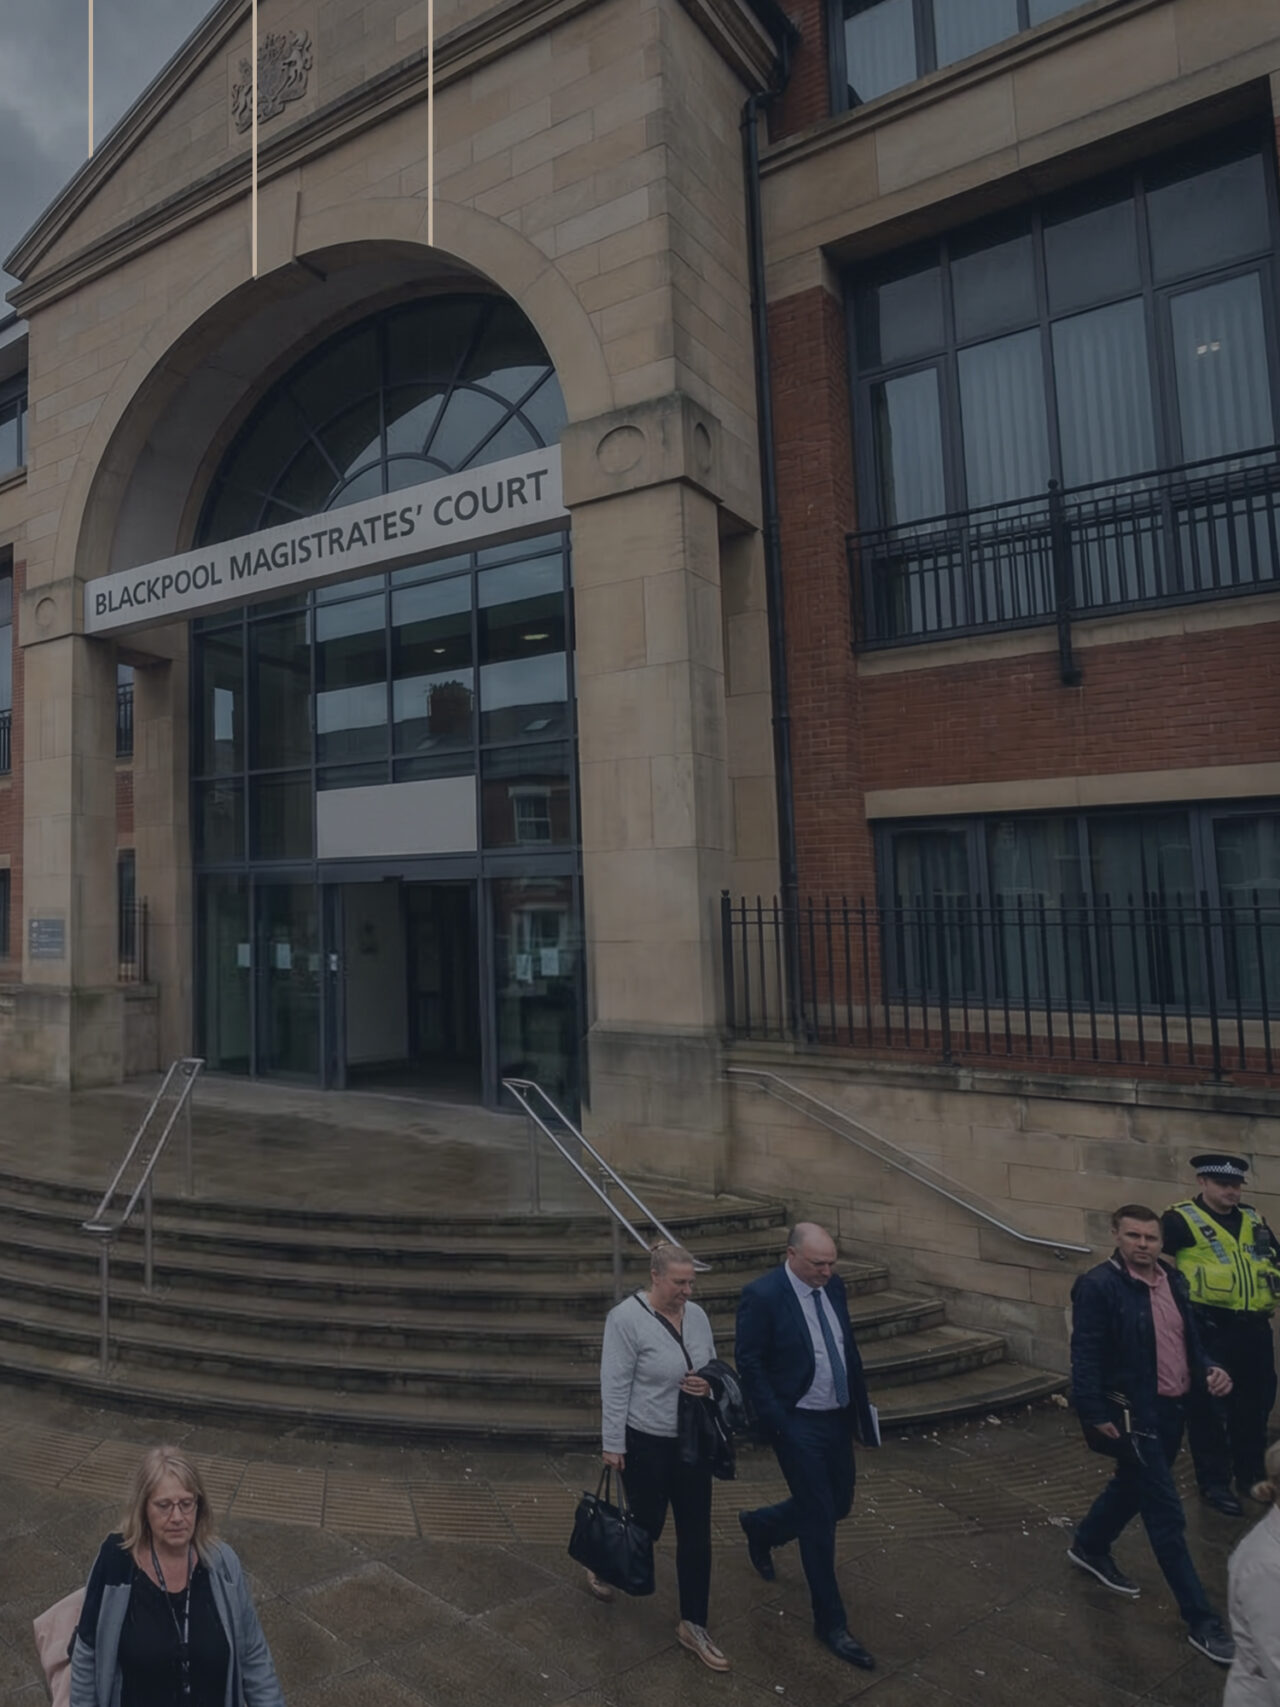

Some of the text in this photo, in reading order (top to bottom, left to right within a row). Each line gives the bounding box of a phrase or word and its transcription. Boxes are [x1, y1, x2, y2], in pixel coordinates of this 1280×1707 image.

[95, 469, 548, 616] BLACKPOOL MAGISTRATES' COURT
